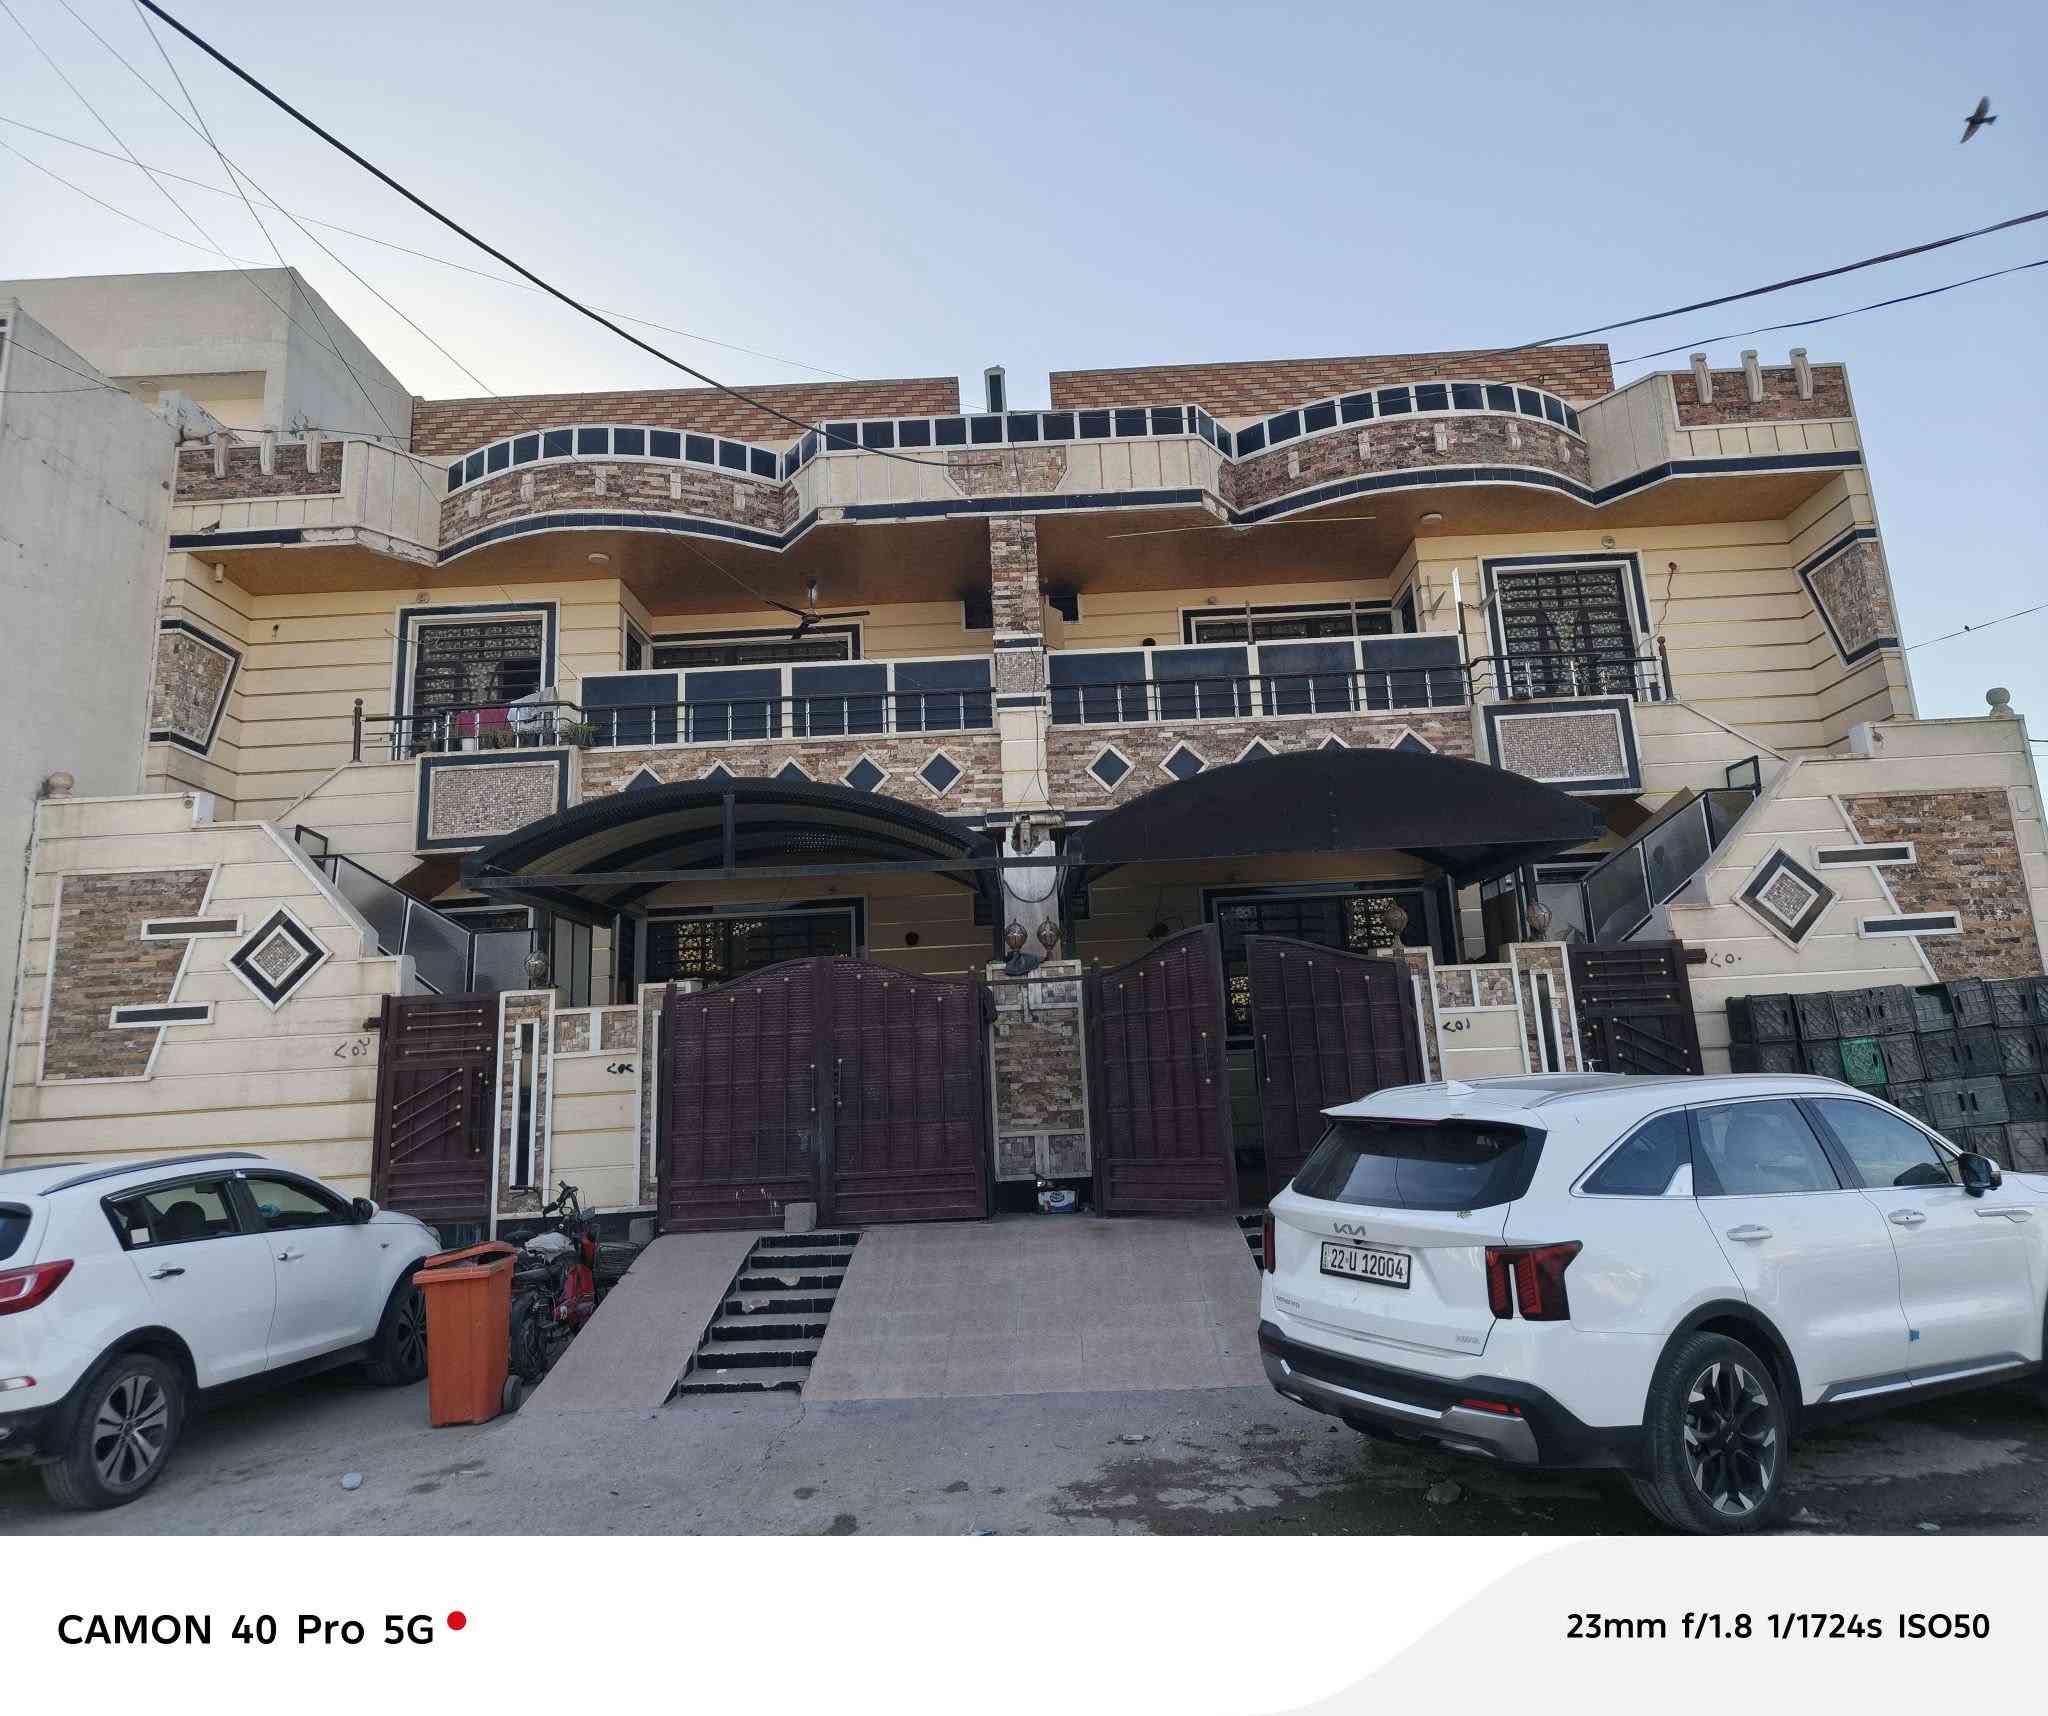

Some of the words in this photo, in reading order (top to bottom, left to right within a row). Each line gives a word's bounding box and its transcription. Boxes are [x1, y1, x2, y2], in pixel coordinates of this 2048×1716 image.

[1330, 1248, 1345, 1270] 22
[1349, 1250, 1358, 1271] U
[1362, 1253, 1404, 1280] 12004
